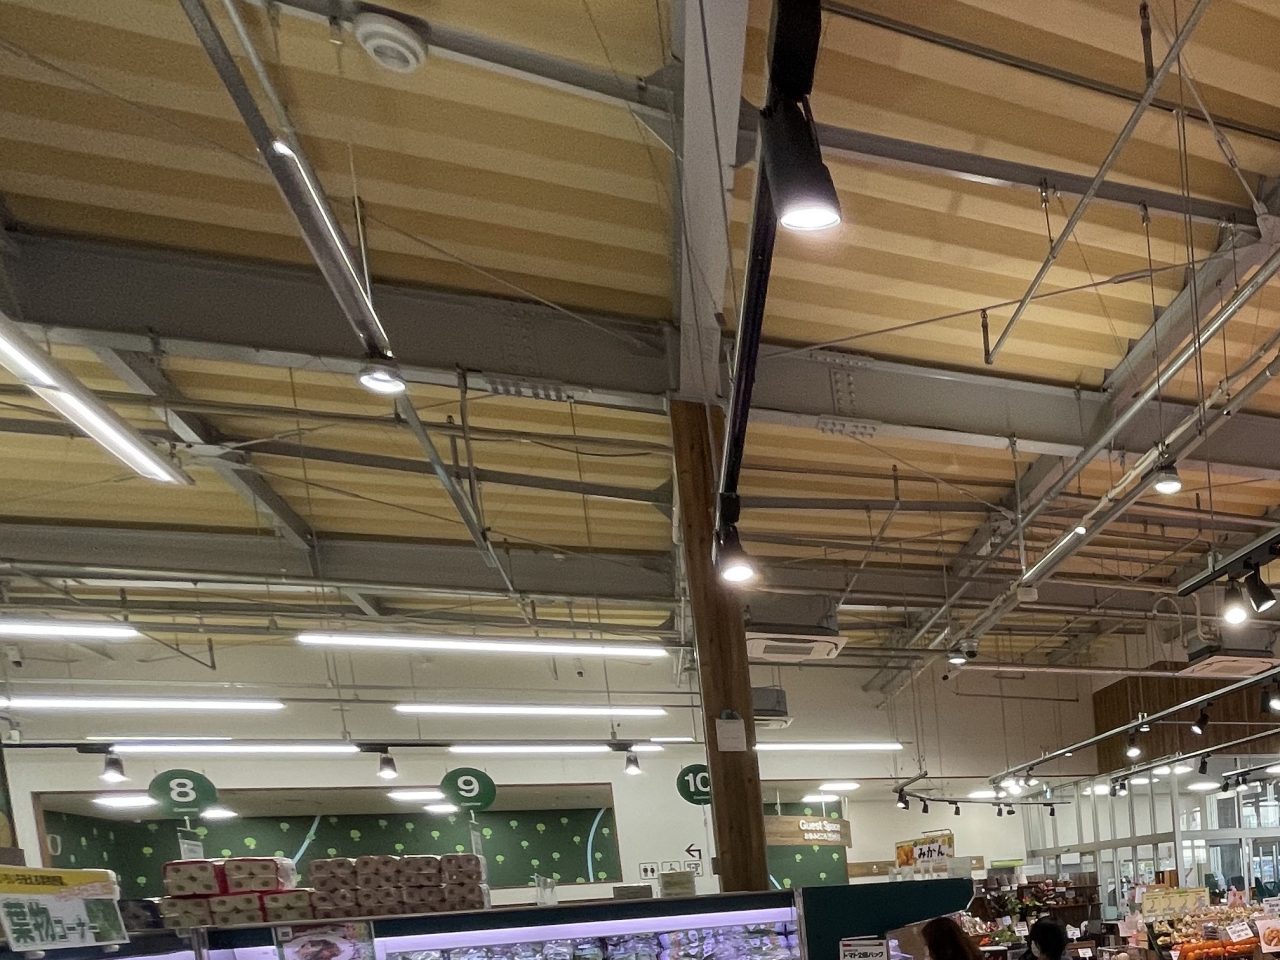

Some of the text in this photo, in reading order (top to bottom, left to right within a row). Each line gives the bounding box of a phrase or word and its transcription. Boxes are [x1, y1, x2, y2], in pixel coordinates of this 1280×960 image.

[169, 778, 197, 802] 8
[457, 775, 480, 797] 9
[918, 845, 945, 859] みかん
[2, 899, 99, 943] 葉物コーナー
